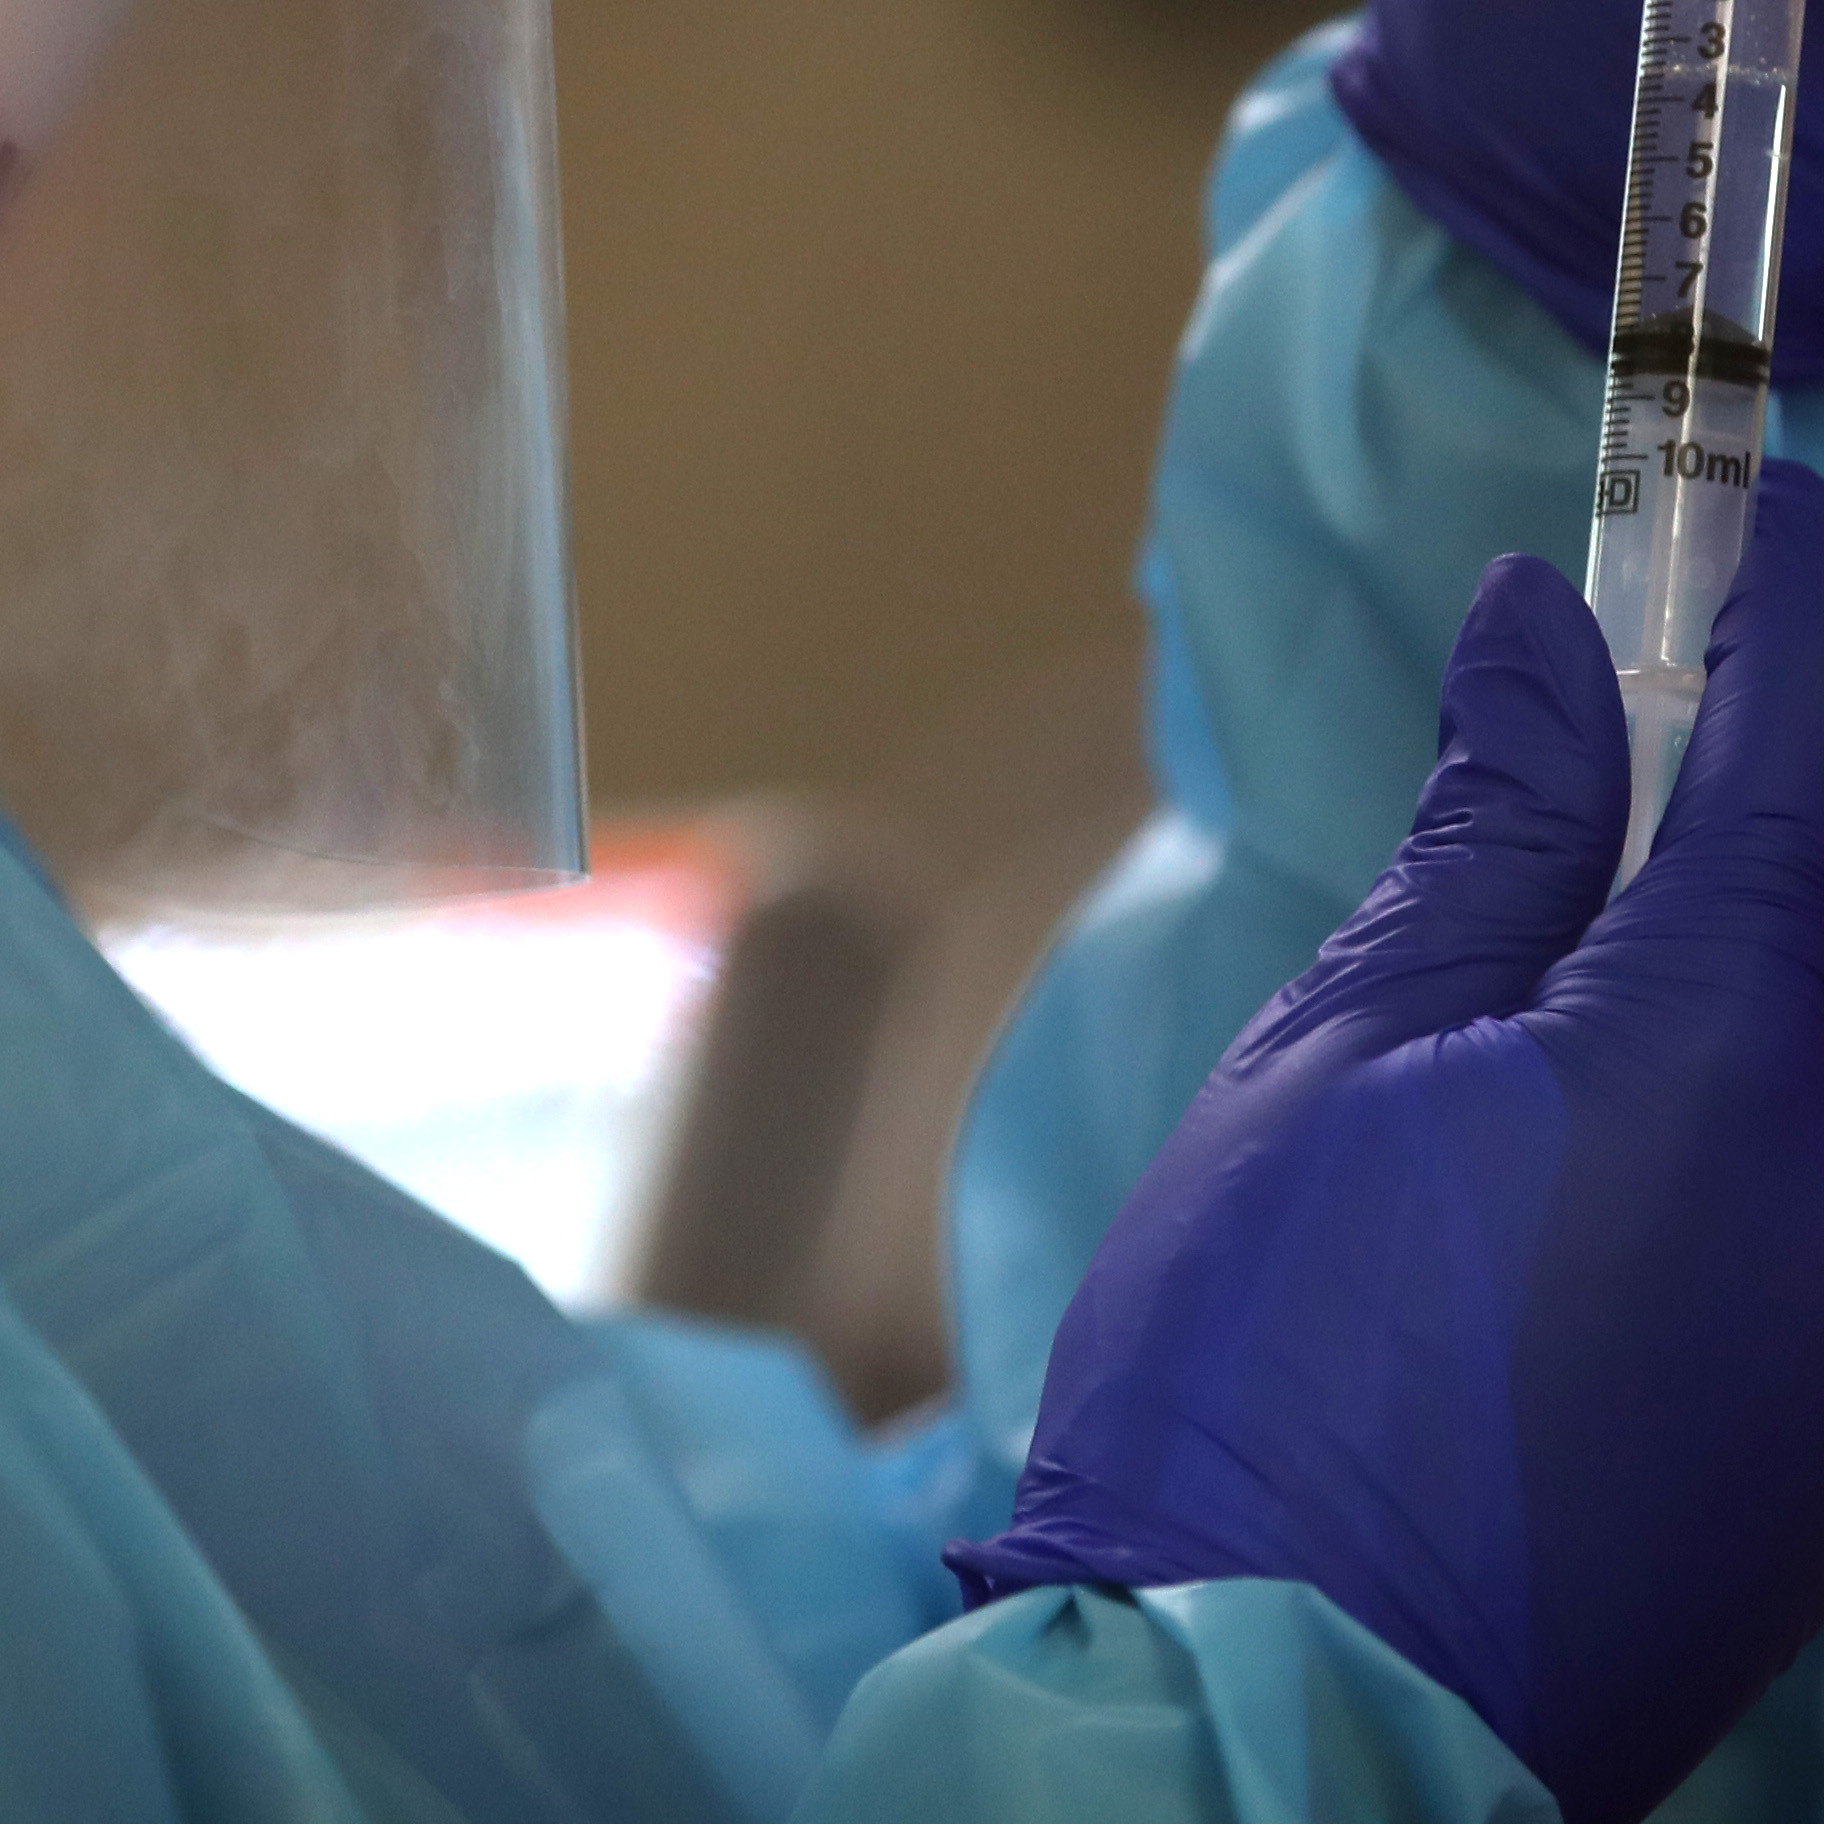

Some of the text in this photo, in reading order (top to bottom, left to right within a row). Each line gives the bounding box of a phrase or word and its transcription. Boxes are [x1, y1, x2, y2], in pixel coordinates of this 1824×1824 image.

[1697, 21, 1725, 59] 3
[1691, 82, 1718, 120] 4
[1686, 142, 1714, 179] 5
[1679, 201, 1707, 239] 6
[1675, 260, 1703, 297] 7
[1662, 380, 1690, 418] 9
[1657, 439, 1751, 489] 10ml
